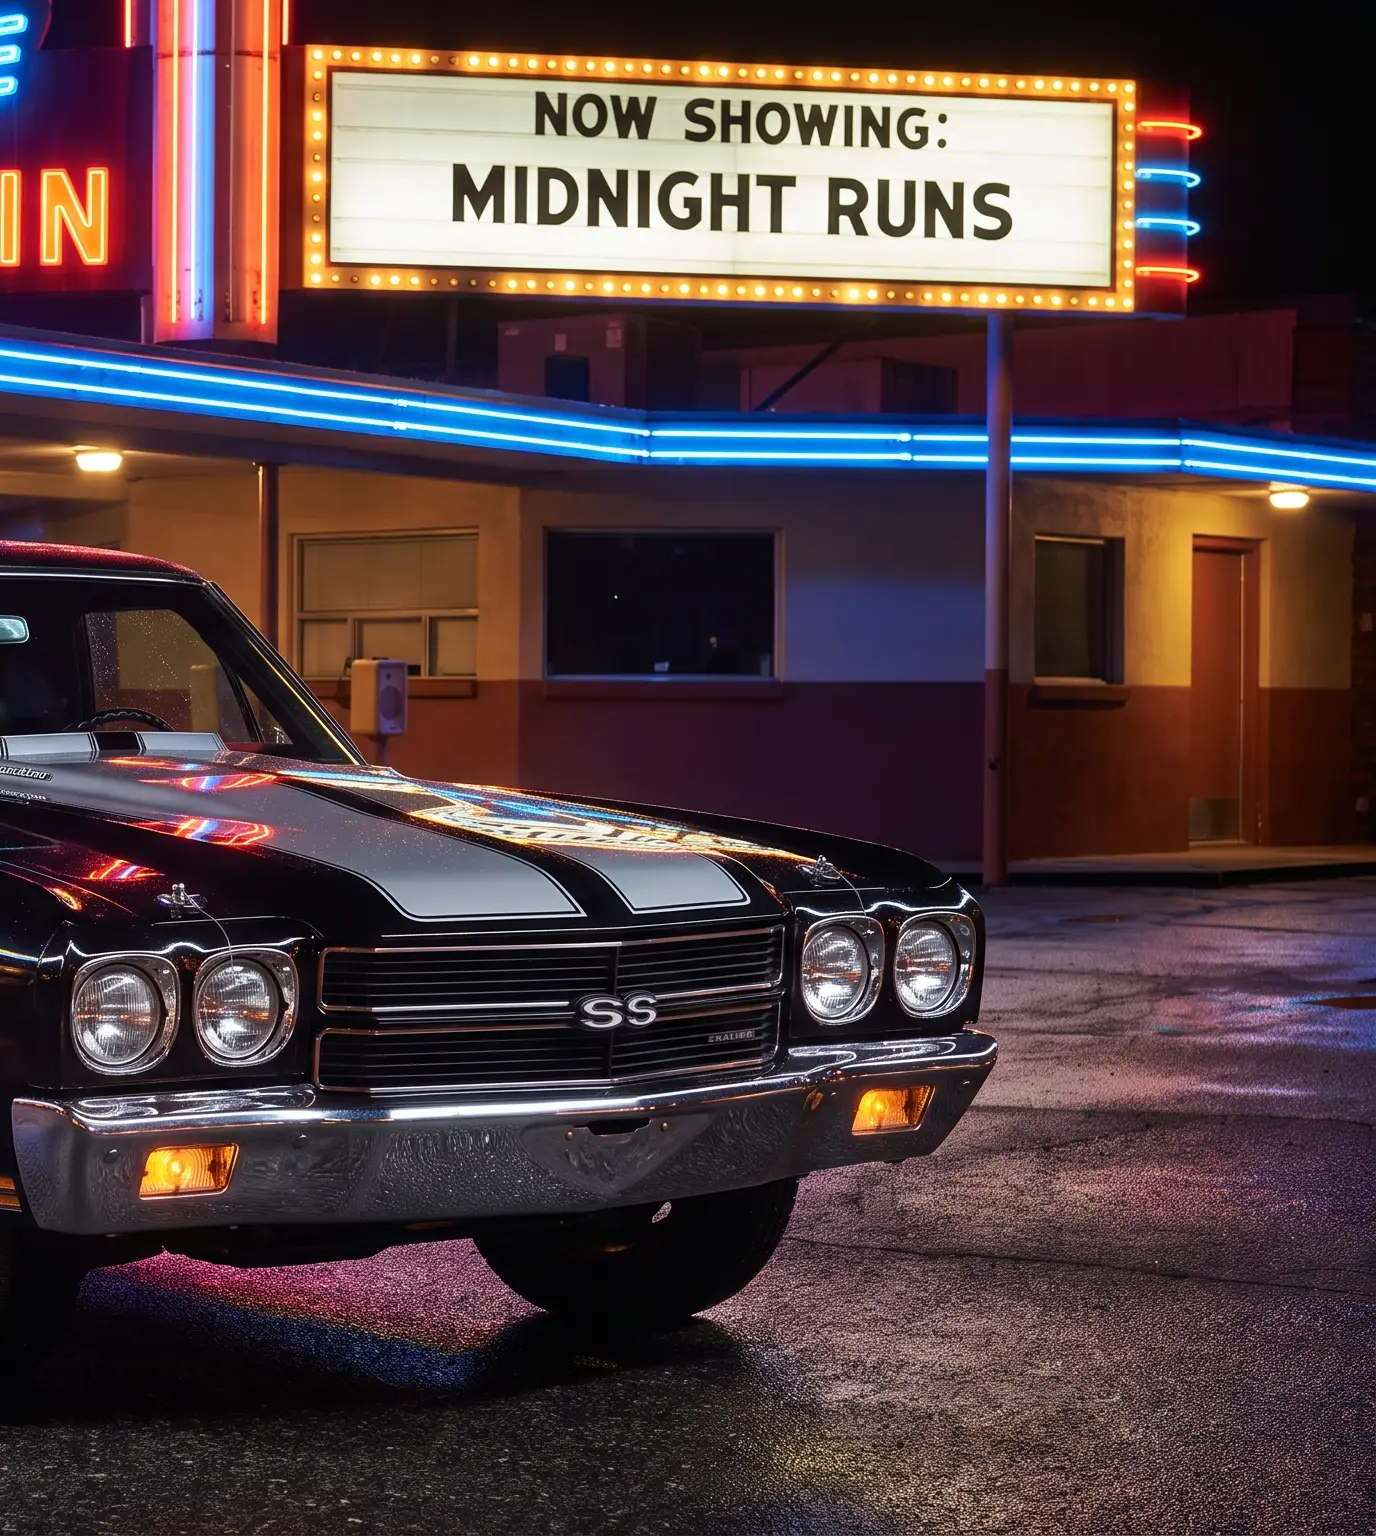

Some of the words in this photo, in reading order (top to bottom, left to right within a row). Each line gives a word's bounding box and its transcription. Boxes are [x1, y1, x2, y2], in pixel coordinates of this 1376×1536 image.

[534, 91, 658, 140] NOW
[684, 97, 948, 151] SHOWING:
[452, 163, 797, 234] MIDNIGHT
[827, 177, 1013, 241] RUNS
[580, 995, 658, 1028] SS
